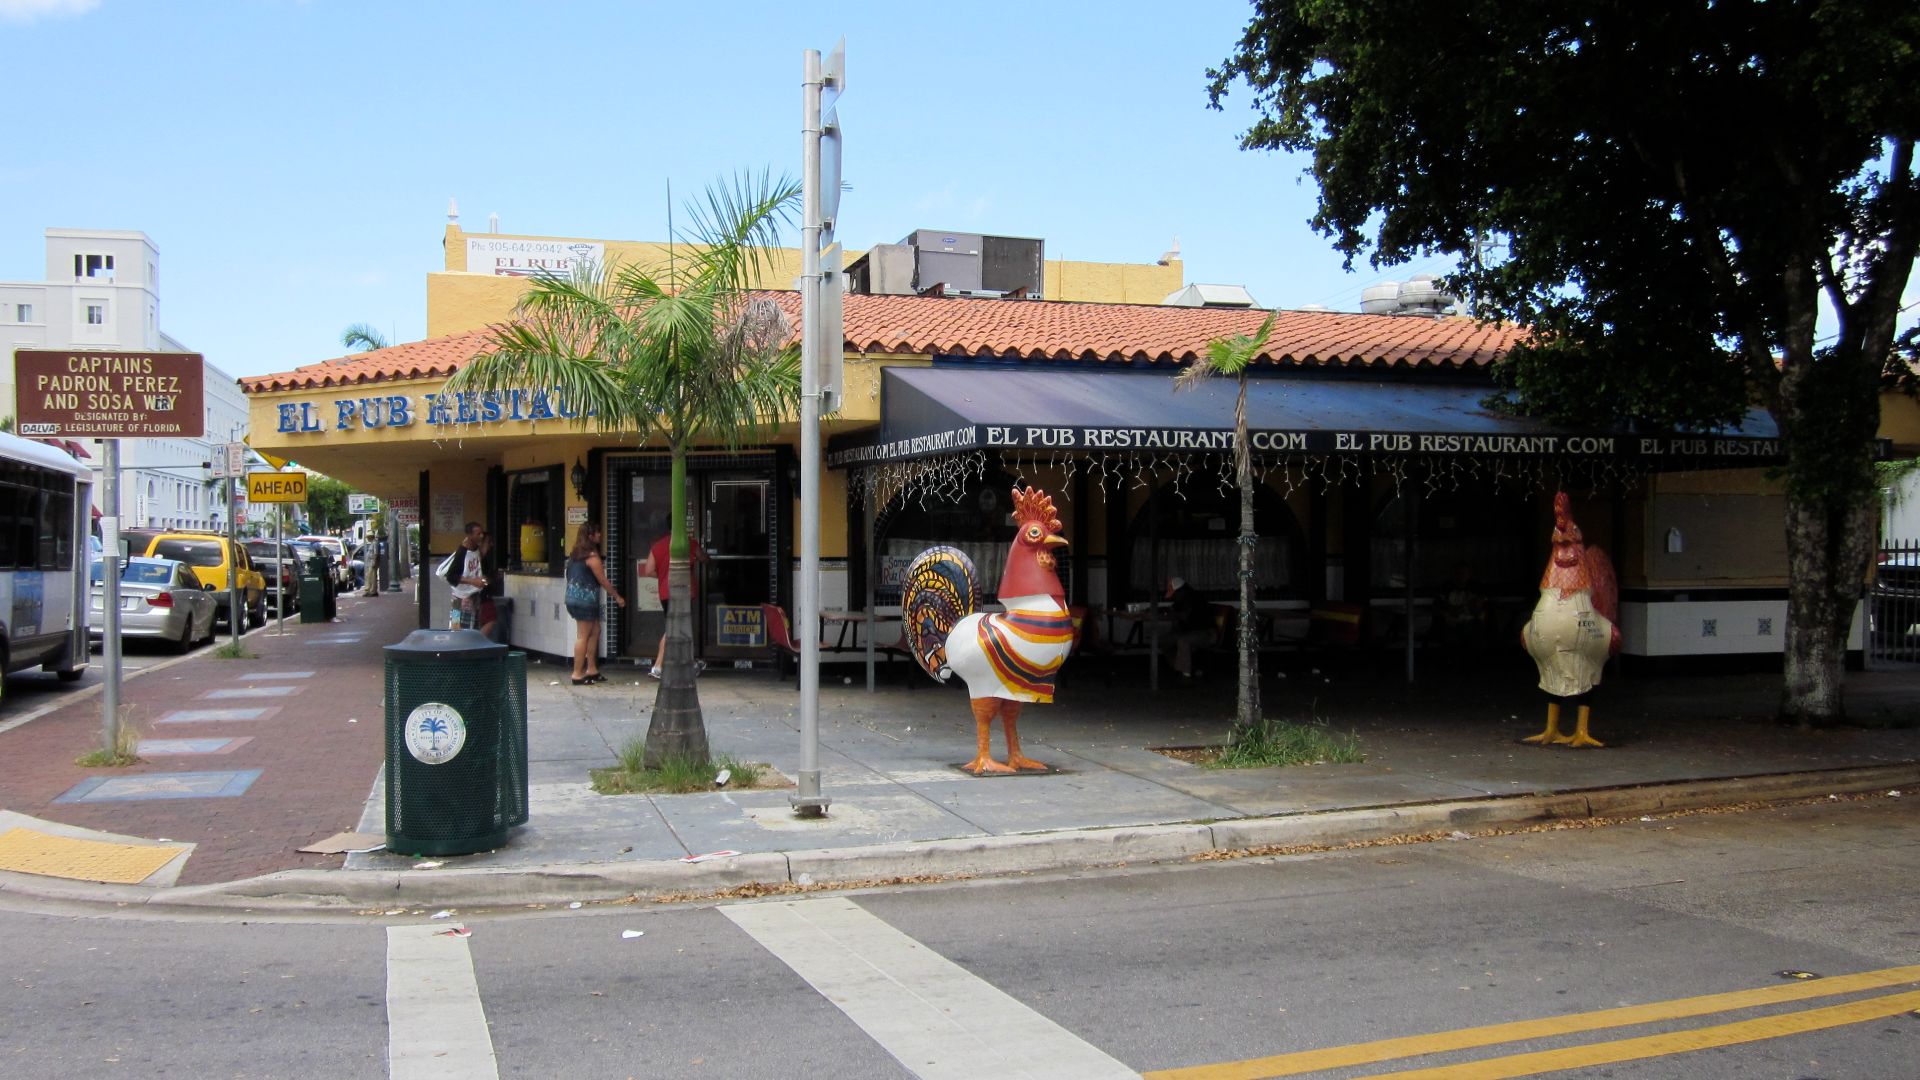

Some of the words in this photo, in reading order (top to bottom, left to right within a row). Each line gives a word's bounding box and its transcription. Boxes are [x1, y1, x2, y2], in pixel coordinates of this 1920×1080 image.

[495, 257, 521, 268] EL
[528, 258, 568, 269] PUB
[68, 356, 153, 374] CAPTAINS
[37, 374, 113, 393] PADRON,
[123, 376, 182, 394] PEREZ,
[43, 394, 79, 410] AND
[88, 394, 134, 410] SOSA
[74, 412, 129, 421] DESIGNATED
[133, 413, 148, 421] BY:
[277, 402, 321, 433] EL
[335, 395, 412, 431] PUB
[65, 423, 124, 433] LEGISLATURE
[128, 424, 140, 432] OF
[143, 424, 181, 433] FLORIDA
[986, 427, 1018, 445] EL
[1026, 428, 1076, 446] PUB
[889, 442, 898, 458] EL
[898, 439, 910, 456] PUB
[1336, 433, 1363, 450] EL
[1370, 434, 1412, 451] PUB
[1640, 438, 1664, 455] EL
[1670, 440, 1708, 455] PUB
[253, 481, 304, 495] AHEAD
[724, 610, 761, 623] ATM
